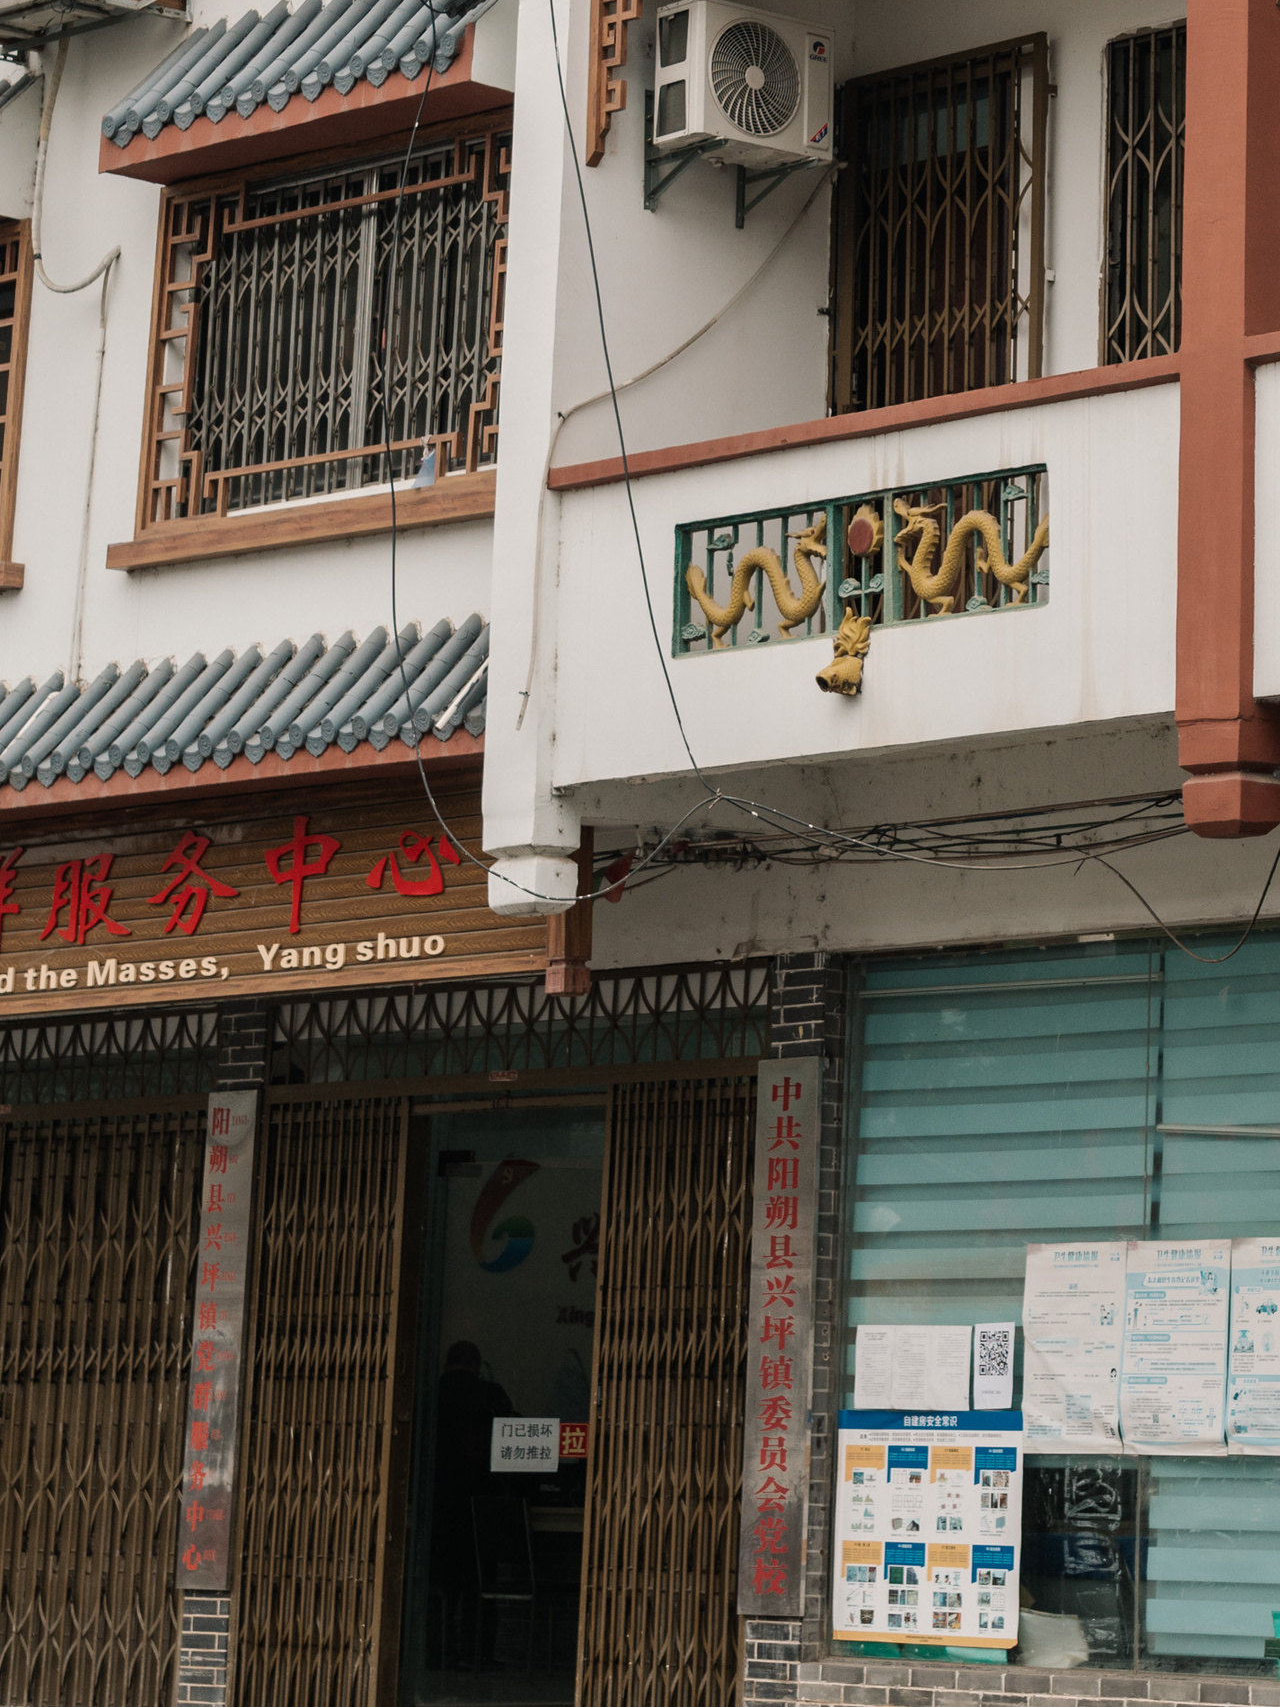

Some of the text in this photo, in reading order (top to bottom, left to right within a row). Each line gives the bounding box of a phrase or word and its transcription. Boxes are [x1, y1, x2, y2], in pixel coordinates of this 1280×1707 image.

[24, 965, 78, 991] the
[86, 956, 230, 987] Masses,
[257, 943, 346, 971] Yang
[356, 932, 445, 961] shuo
[182, 1106, 231, 1571] 阳朔县兴坪镇党群服务中心
[751, 1076, 802, 1595] 中共阳朔县兴坪镇委员会党校
[501, 1423, 552, 1438] 门已损坏
[903, 1415, 958, 1427] 自建房安全常识
[501, 1446, 552, 1460] 请勿推拉
[562, 1426, 586, 1454] 拉
